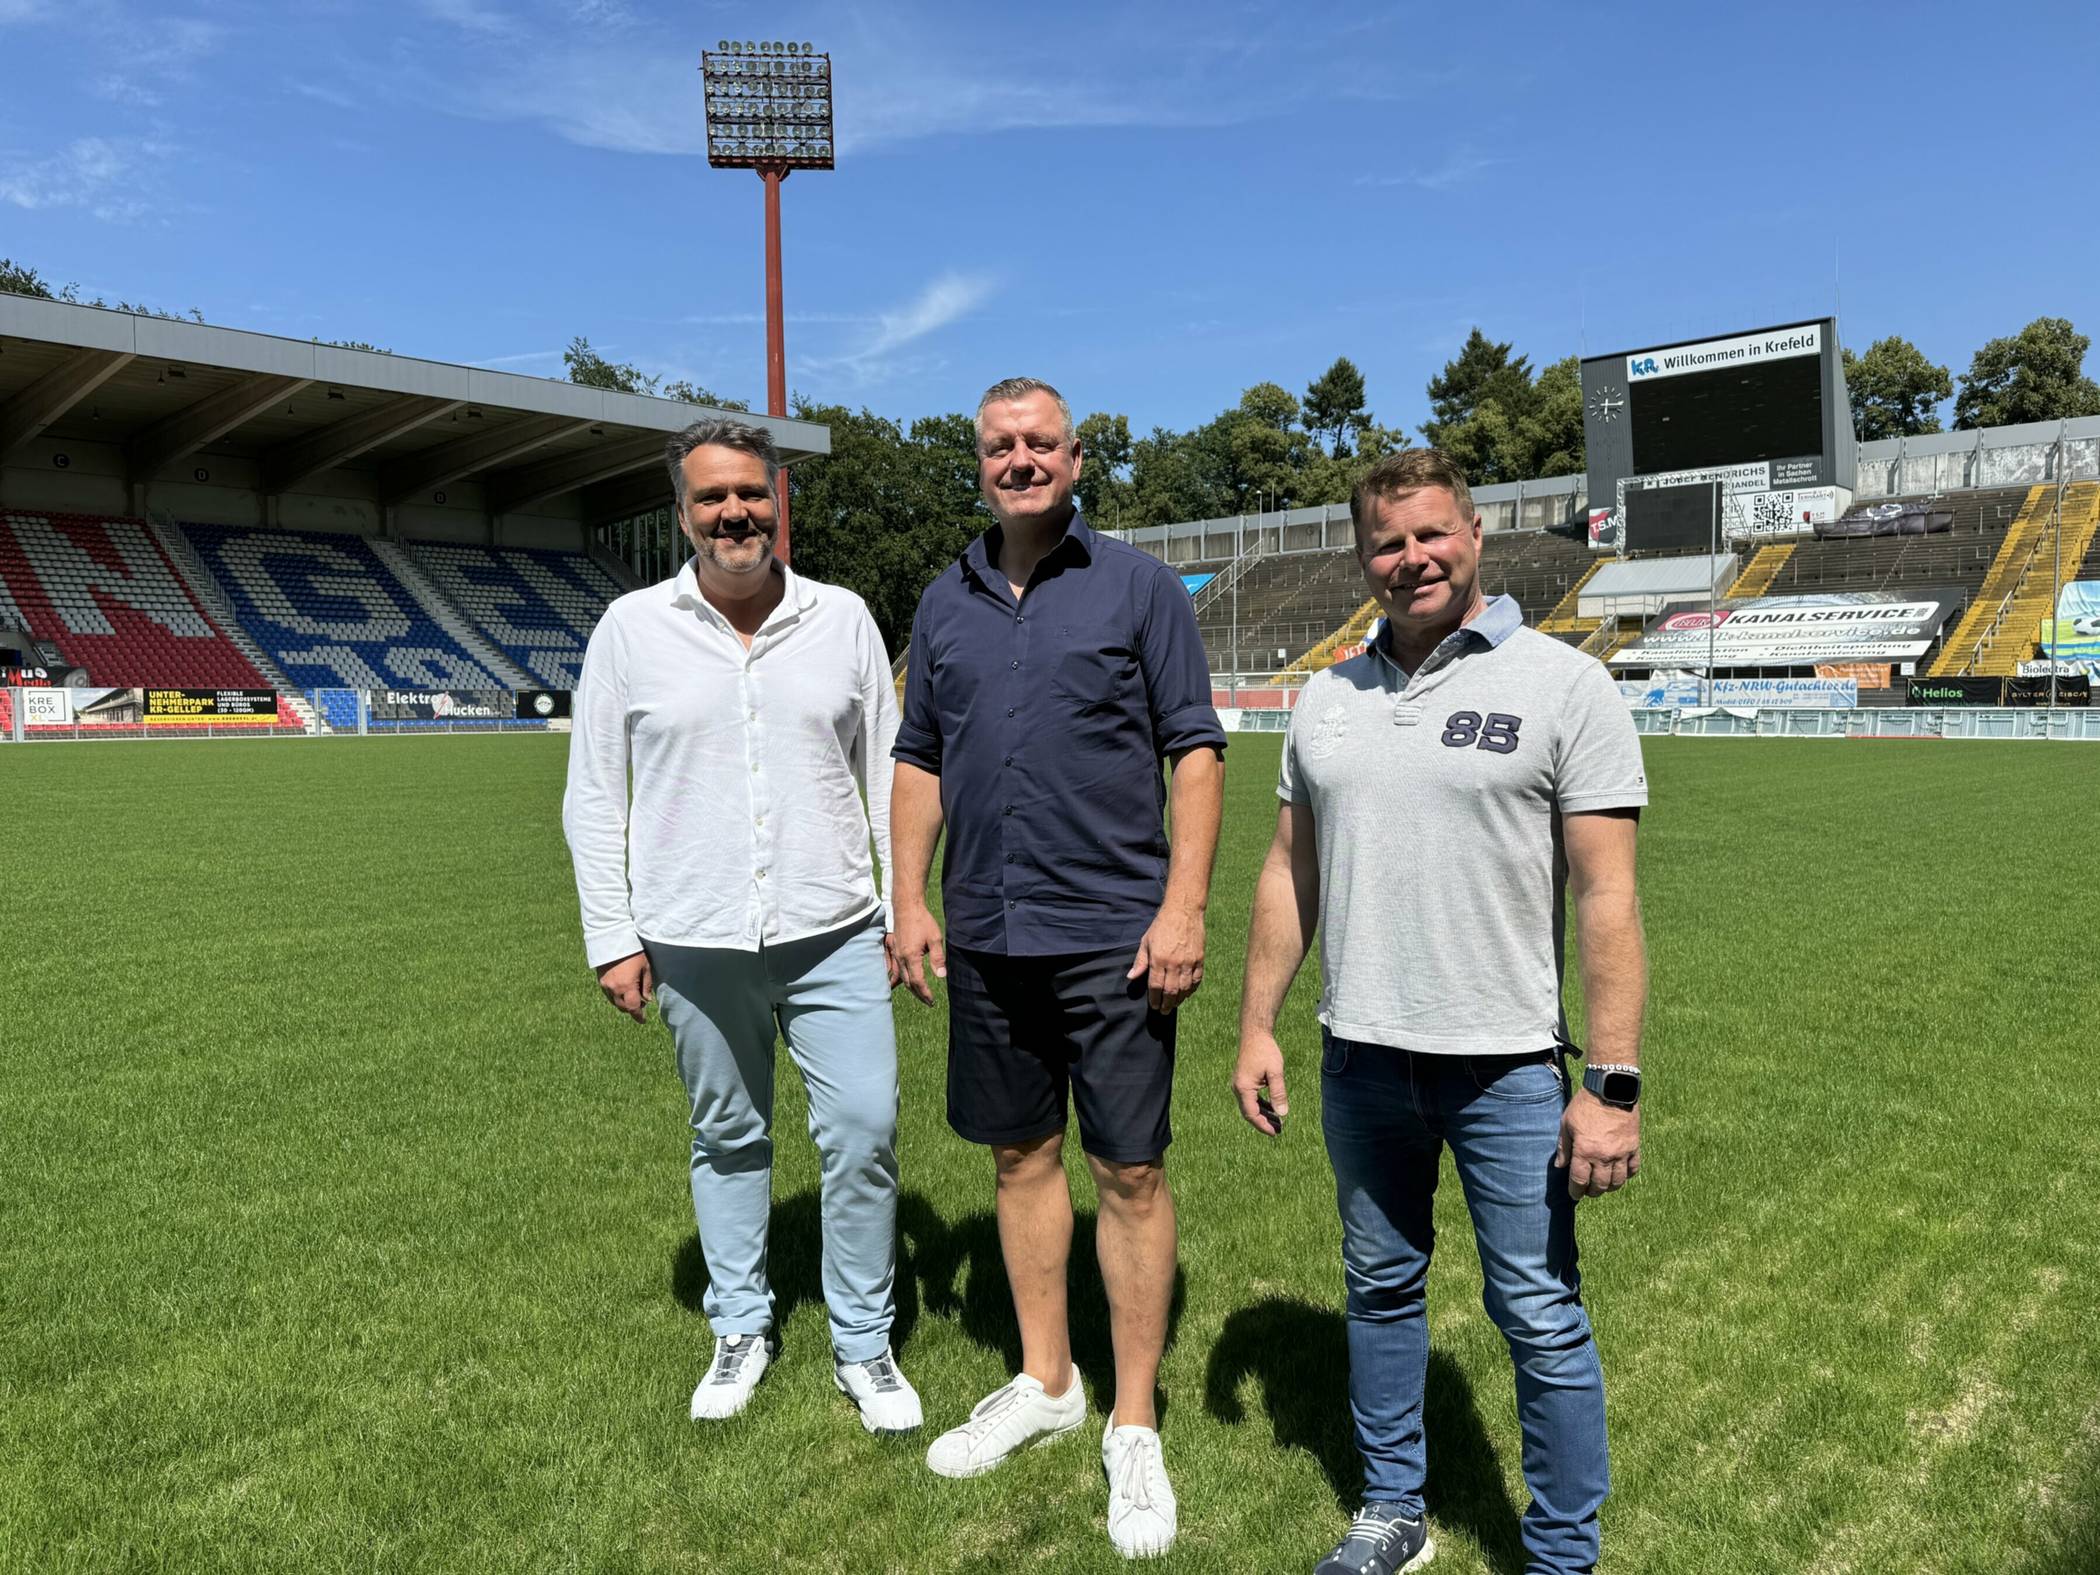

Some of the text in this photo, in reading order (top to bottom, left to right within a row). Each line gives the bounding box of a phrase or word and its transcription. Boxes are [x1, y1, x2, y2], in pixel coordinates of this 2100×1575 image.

[1664, 349, 1744, 369] Willkommen
[1749, 344, 1761, 356] in
[1765, 334, 1814, 353] Krefeld
[1776, 461, 1813, 471] Ihr Partner
[1778, 469, 1812, 478] in Sachen
[1773, 475, 1817, 485] Metallschrott
[1728, 608, 1915, 624] KANALSERVICE
[149, 691, 185, 699] UNTER-
[387, 692, 438, 704] Elektro
[1923, 688, 1963, 698] Helios
[28, 697, 53, 705] KRE
[150, 698, 214, 706] NEHMERPARK
[29, 706, 55, 714] BOX
[1441, 711, 1522, 754] 85
